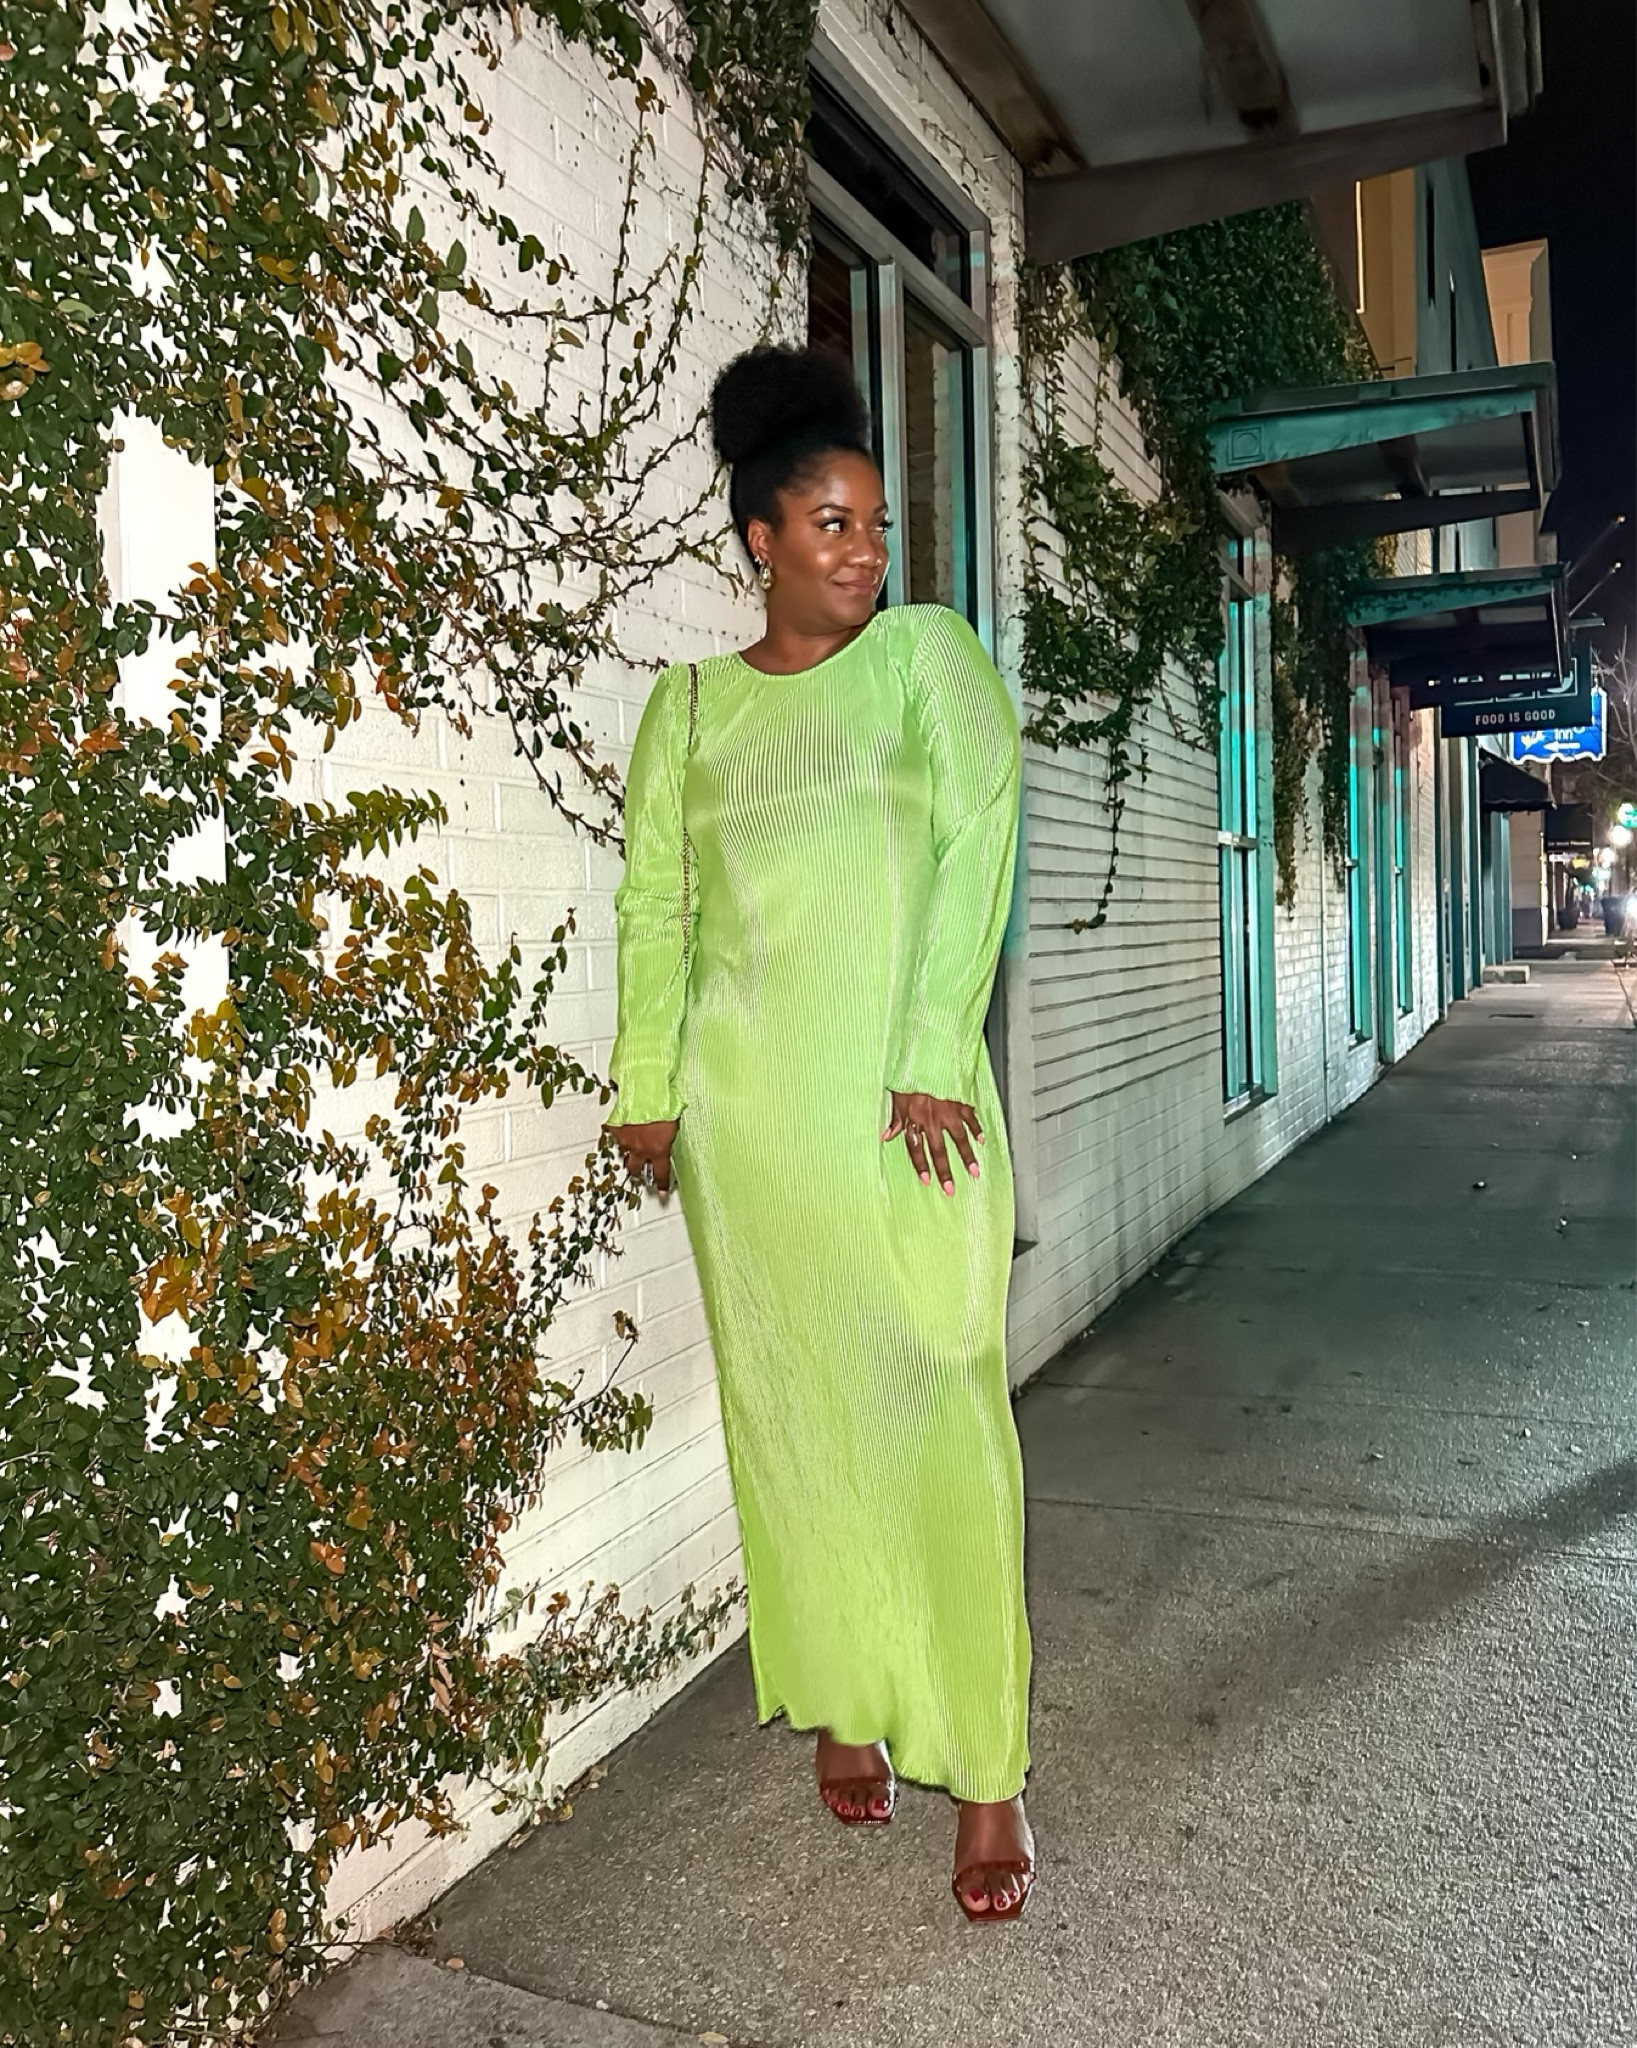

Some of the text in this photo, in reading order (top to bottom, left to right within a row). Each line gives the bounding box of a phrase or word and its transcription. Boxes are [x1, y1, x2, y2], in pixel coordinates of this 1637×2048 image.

[1475, 709, 1556, 725] FOOD IS GOOD
